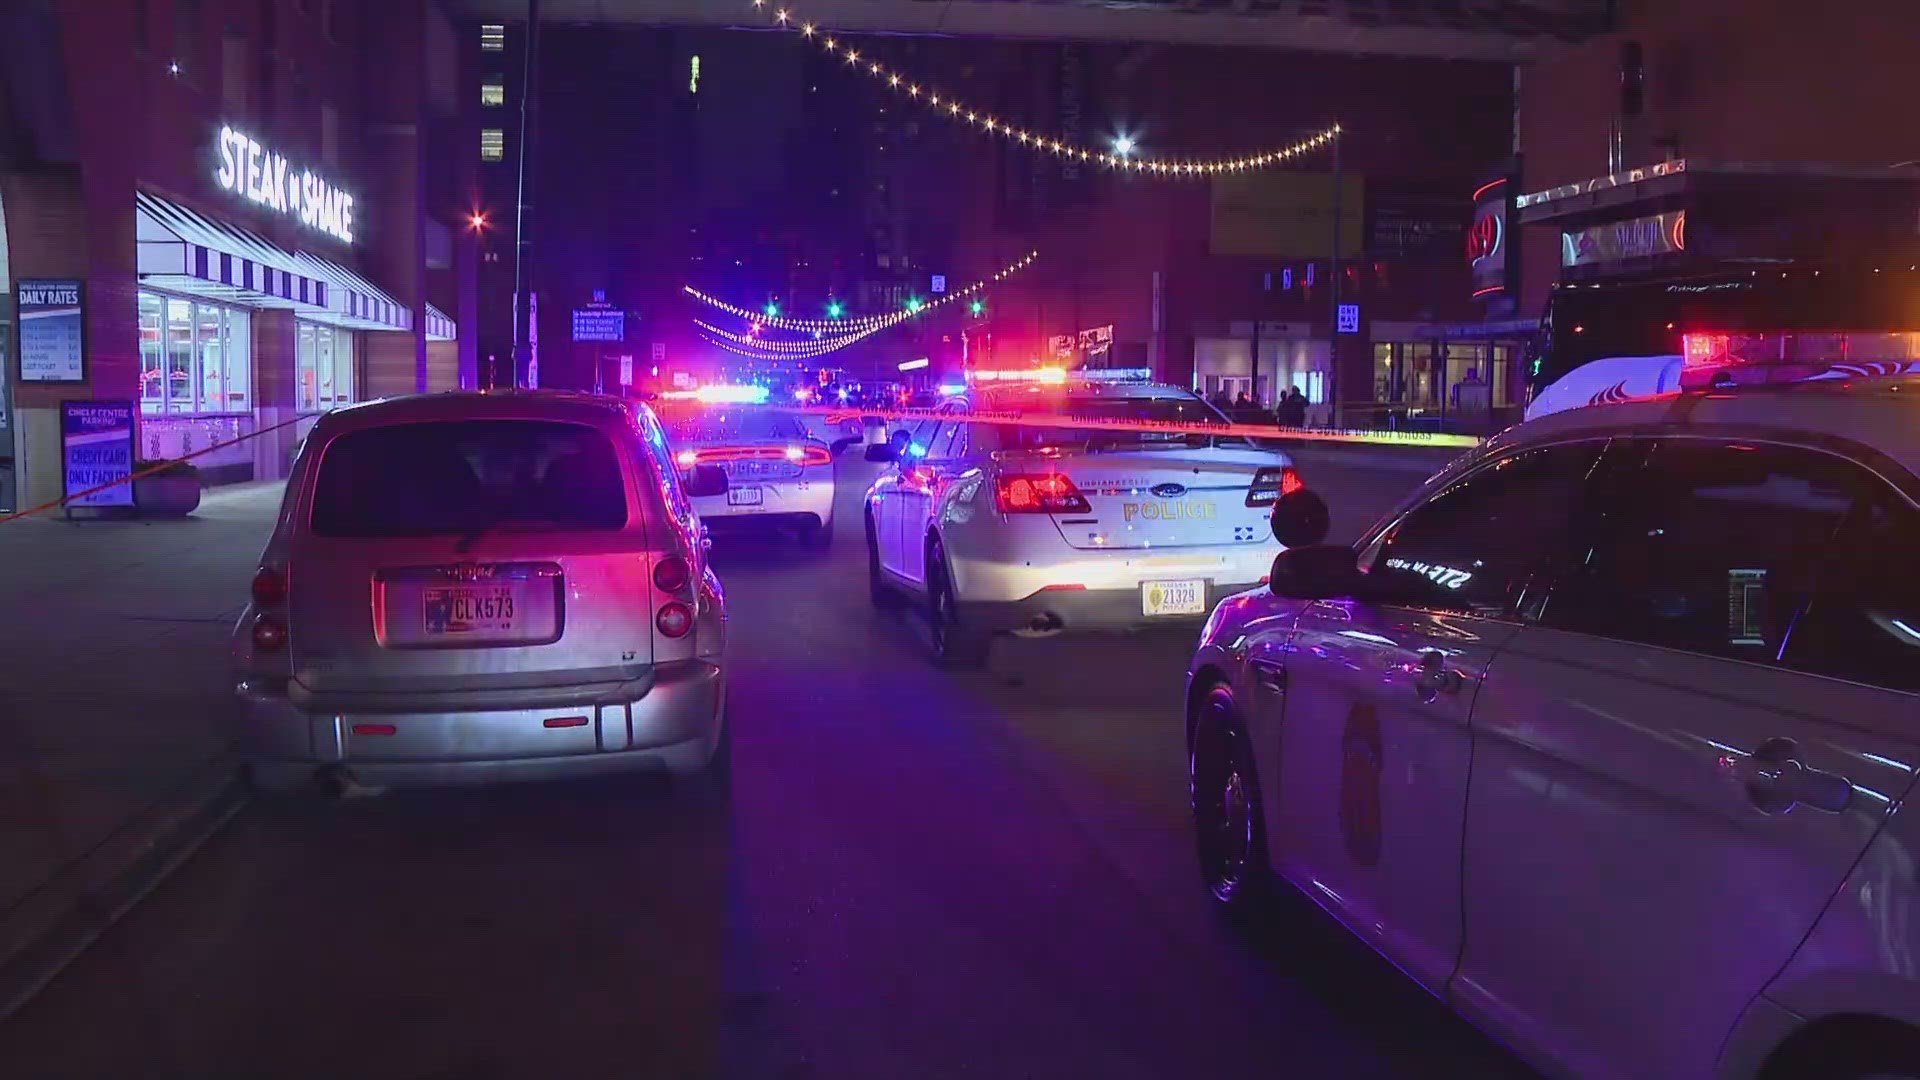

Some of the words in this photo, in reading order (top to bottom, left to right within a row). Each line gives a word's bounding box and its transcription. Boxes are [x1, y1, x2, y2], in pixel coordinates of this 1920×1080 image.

[218, 124, 288, 215] STEAK
[301, 168, 353, 243] SHAKE
[20, 291, 46, 305] DAILY
[47, 291, 78, 305] RATES
[1340, 306, 1356, 314] ONE
[68, 470, 91, 485] ONLY
[1123, 501, 1218, 522] POLICE
[1163, 588, 1195, 604] 21329
[455, 597, 514, 620] CLK573
